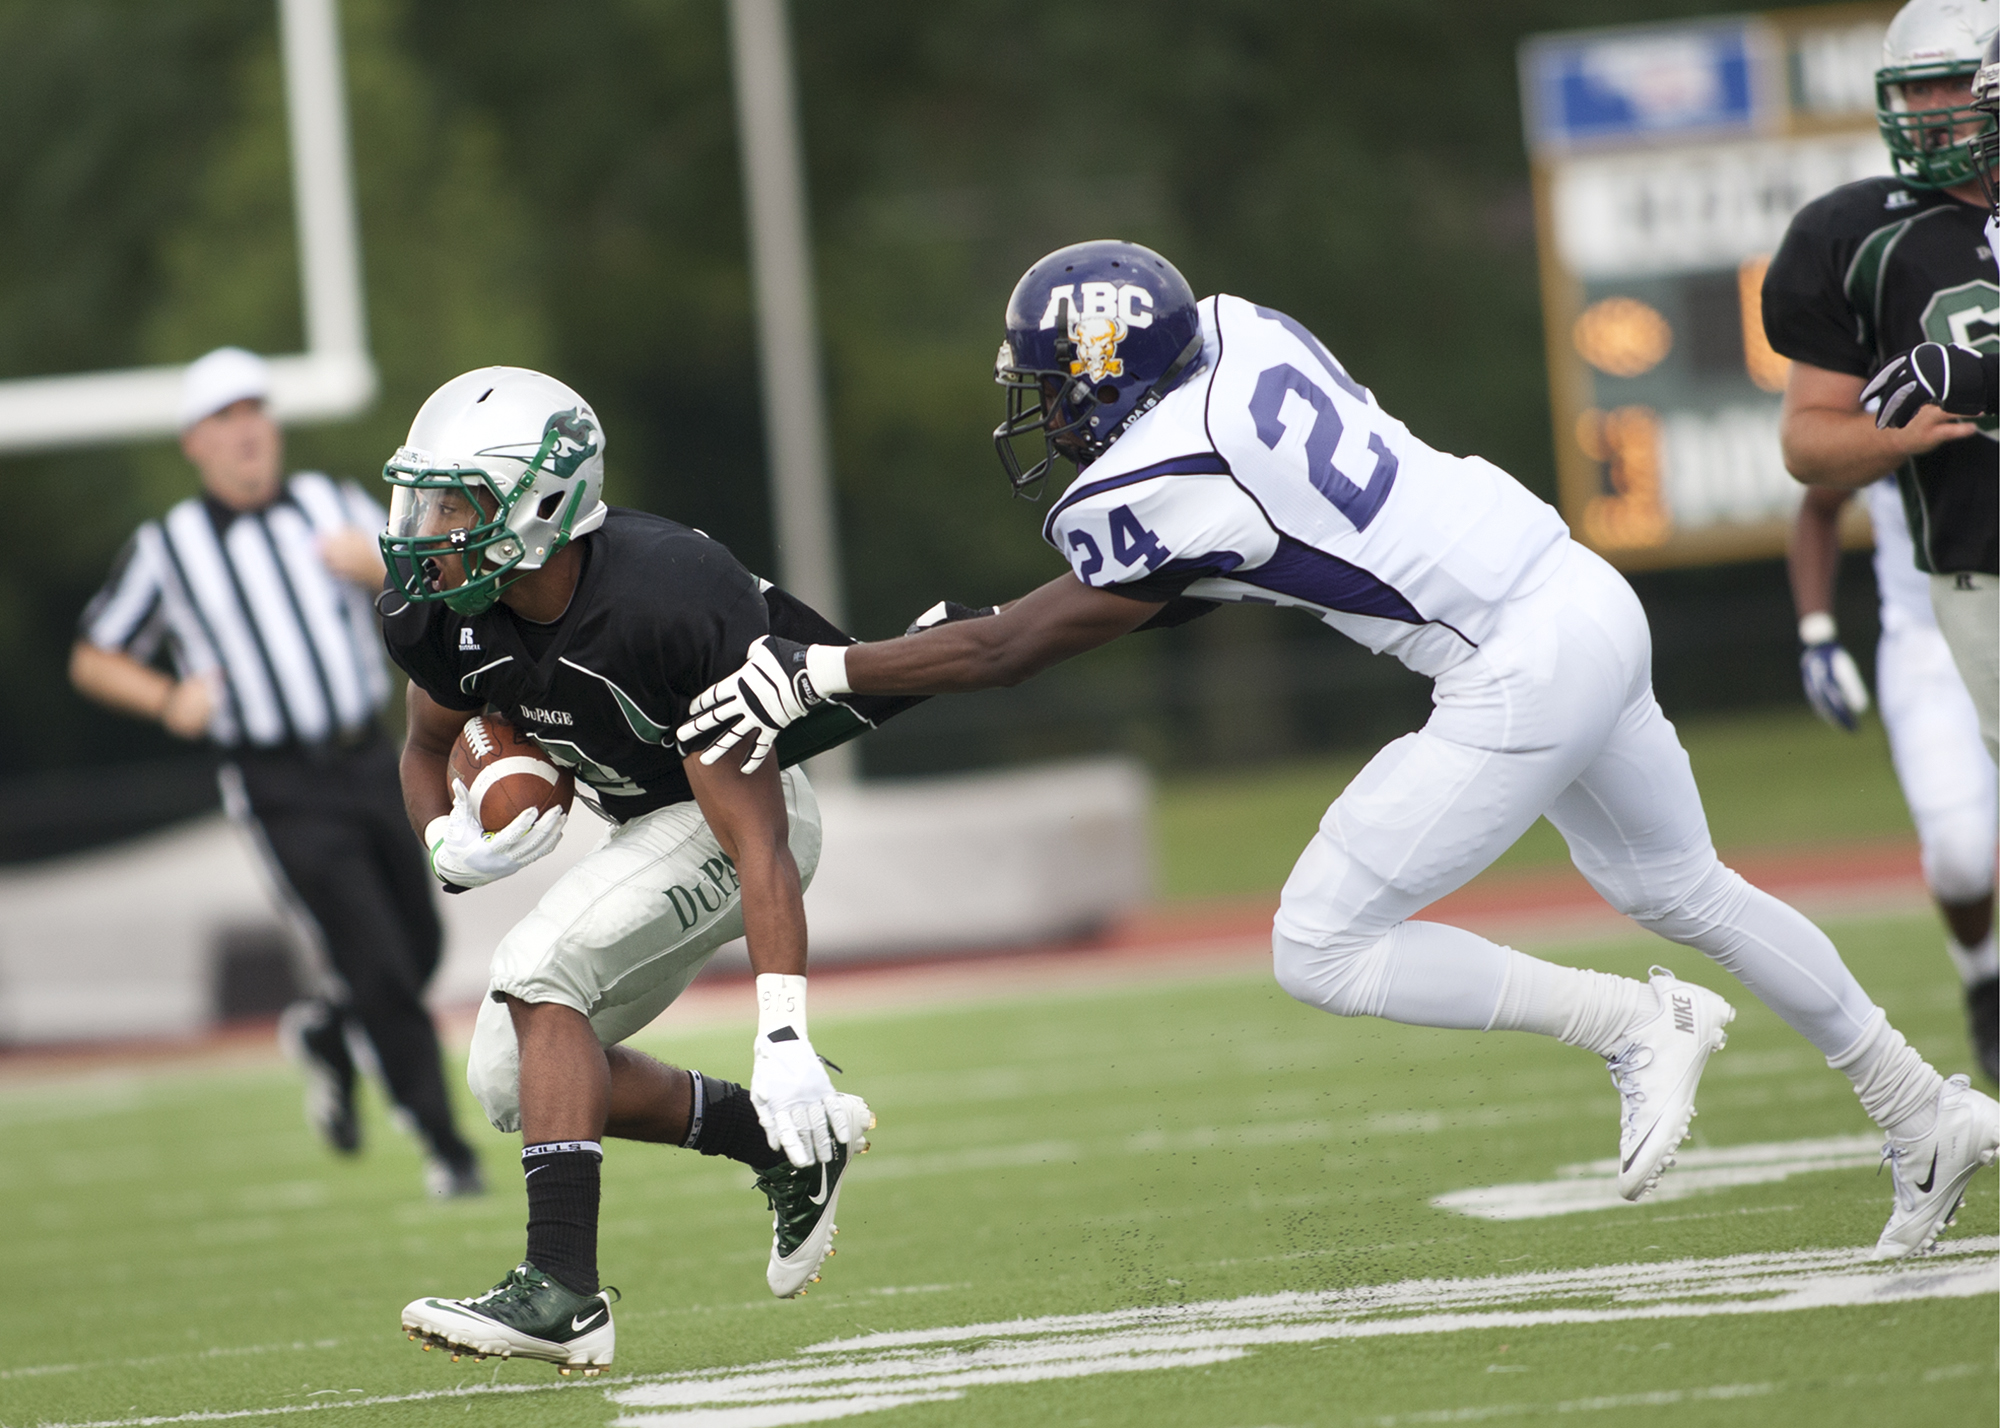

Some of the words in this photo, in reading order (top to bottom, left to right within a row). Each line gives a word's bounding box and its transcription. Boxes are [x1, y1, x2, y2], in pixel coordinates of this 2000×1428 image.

[1039, 281, 1154, 331] ABC
[1067, 503, 1172, 587] 24
[460, 627, 474, 645] R
[1671, 993, 1695, 1035] NIKE
